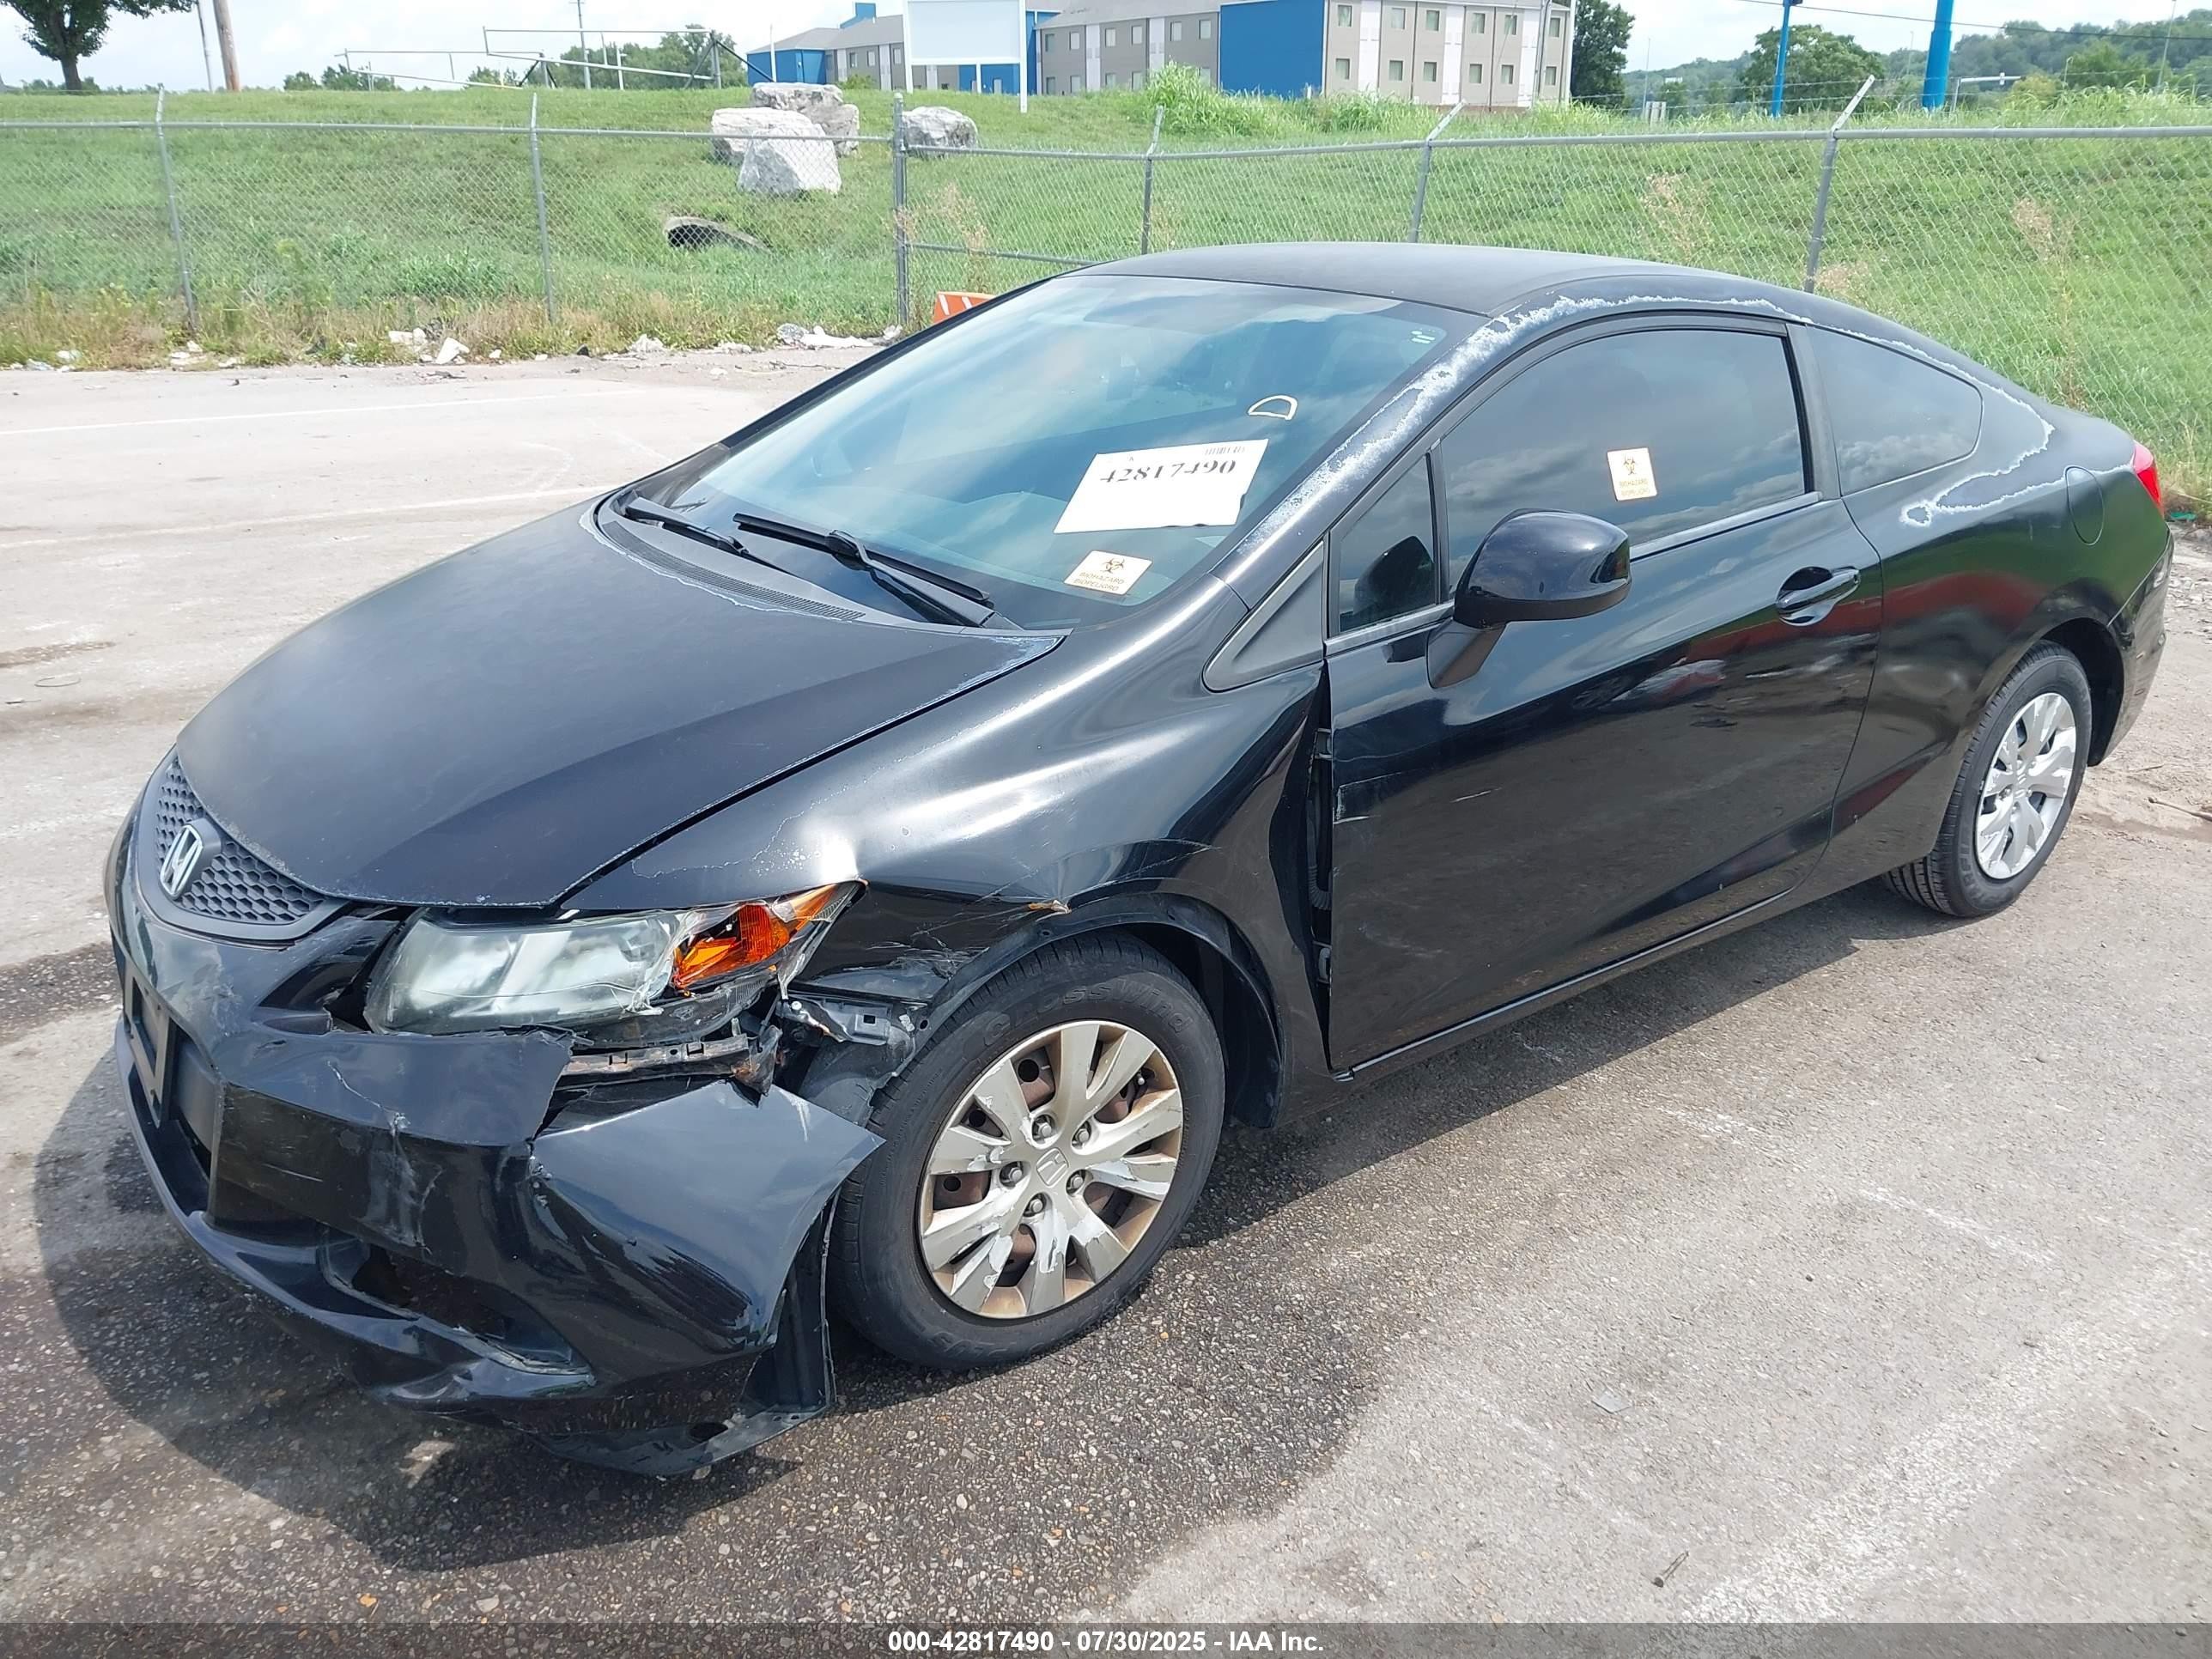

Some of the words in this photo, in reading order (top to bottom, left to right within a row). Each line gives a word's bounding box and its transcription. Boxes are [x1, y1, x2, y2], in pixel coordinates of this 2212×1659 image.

[1099, 459, 1237, 483] 42817490
[1073, 578, 1120, 592] BIOPELIGRO
[1079, 572, 1125, 585] BIOHAZARD
